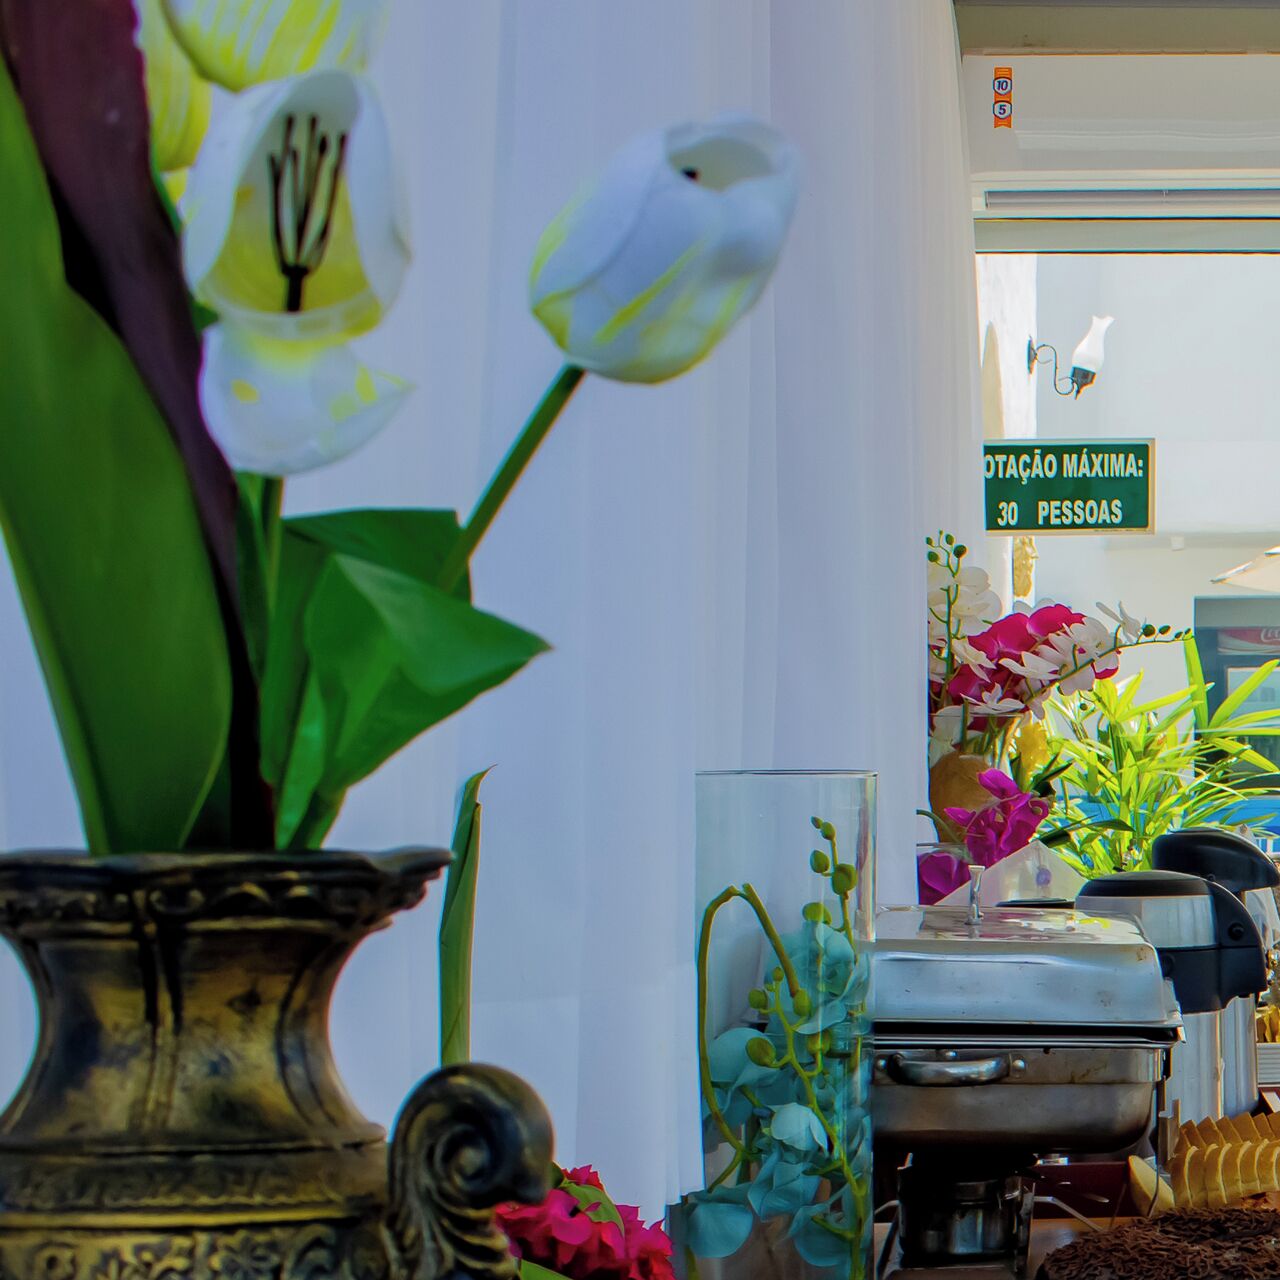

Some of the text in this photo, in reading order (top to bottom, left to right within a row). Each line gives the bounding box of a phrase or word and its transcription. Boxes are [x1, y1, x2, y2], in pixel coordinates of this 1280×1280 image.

[997, 80, 1009, 91] 10
[998, 104, 1007, 116] 5
[985, 448, 1144, 485] OTAÇÃO MÁXIMA:
[997, 499, 1123, 526] 30 PESSOAS
